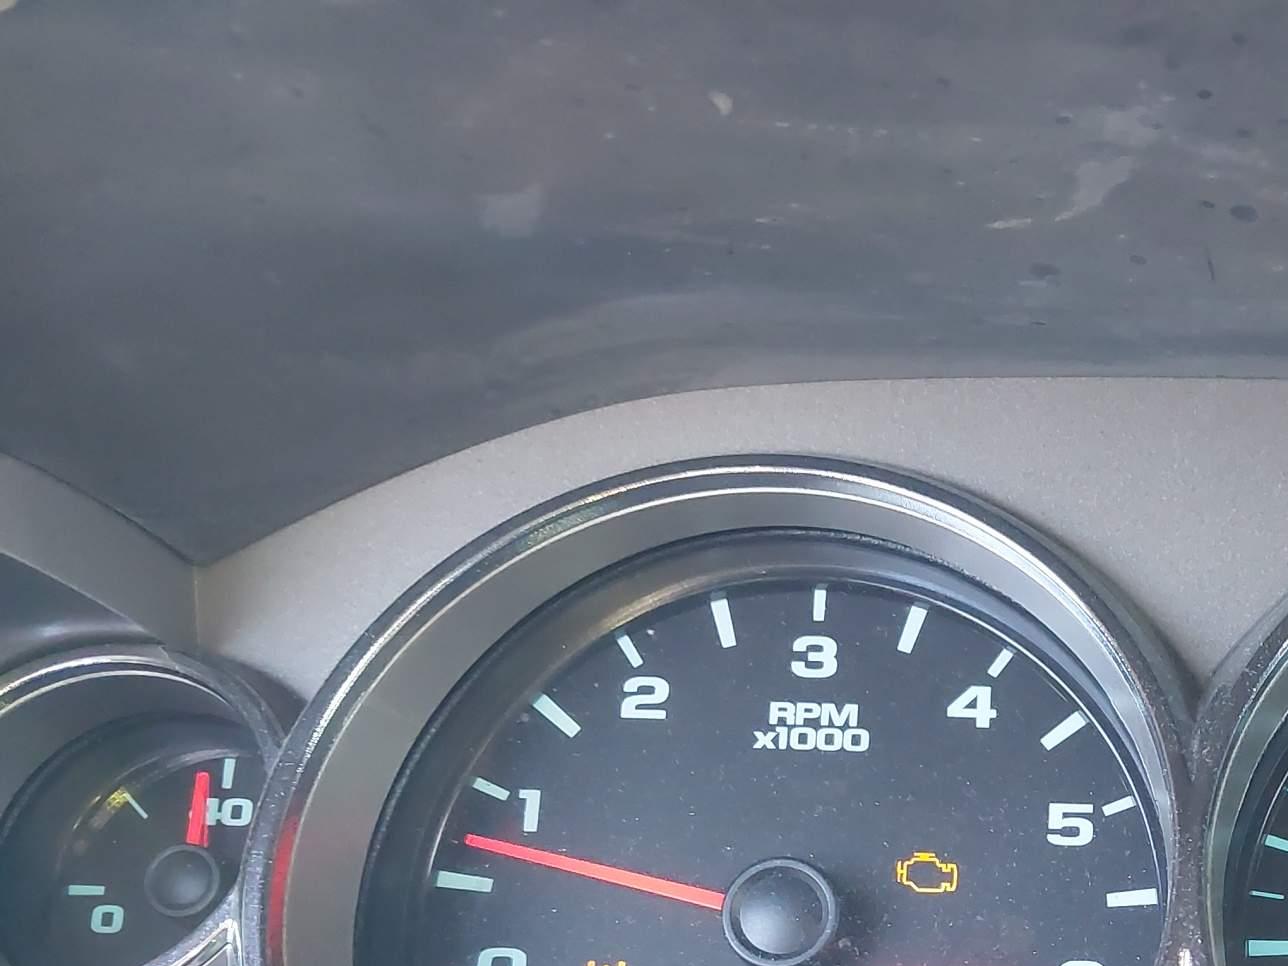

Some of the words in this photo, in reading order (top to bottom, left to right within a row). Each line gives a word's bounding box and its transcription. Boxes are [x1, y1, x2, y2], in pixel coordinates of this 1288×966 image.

[791, 635, 838, 678] 3
[620, 677, 670, 720] 2
[769, 702, 858, 727] RPM
[947, 686, 997, 728] 4
[753, 728, 870, 752] x1000
[519, 790, 541, 832] 1
[1047, 803, 1094, 846] 5
[90, 905, 124, 934] 0
